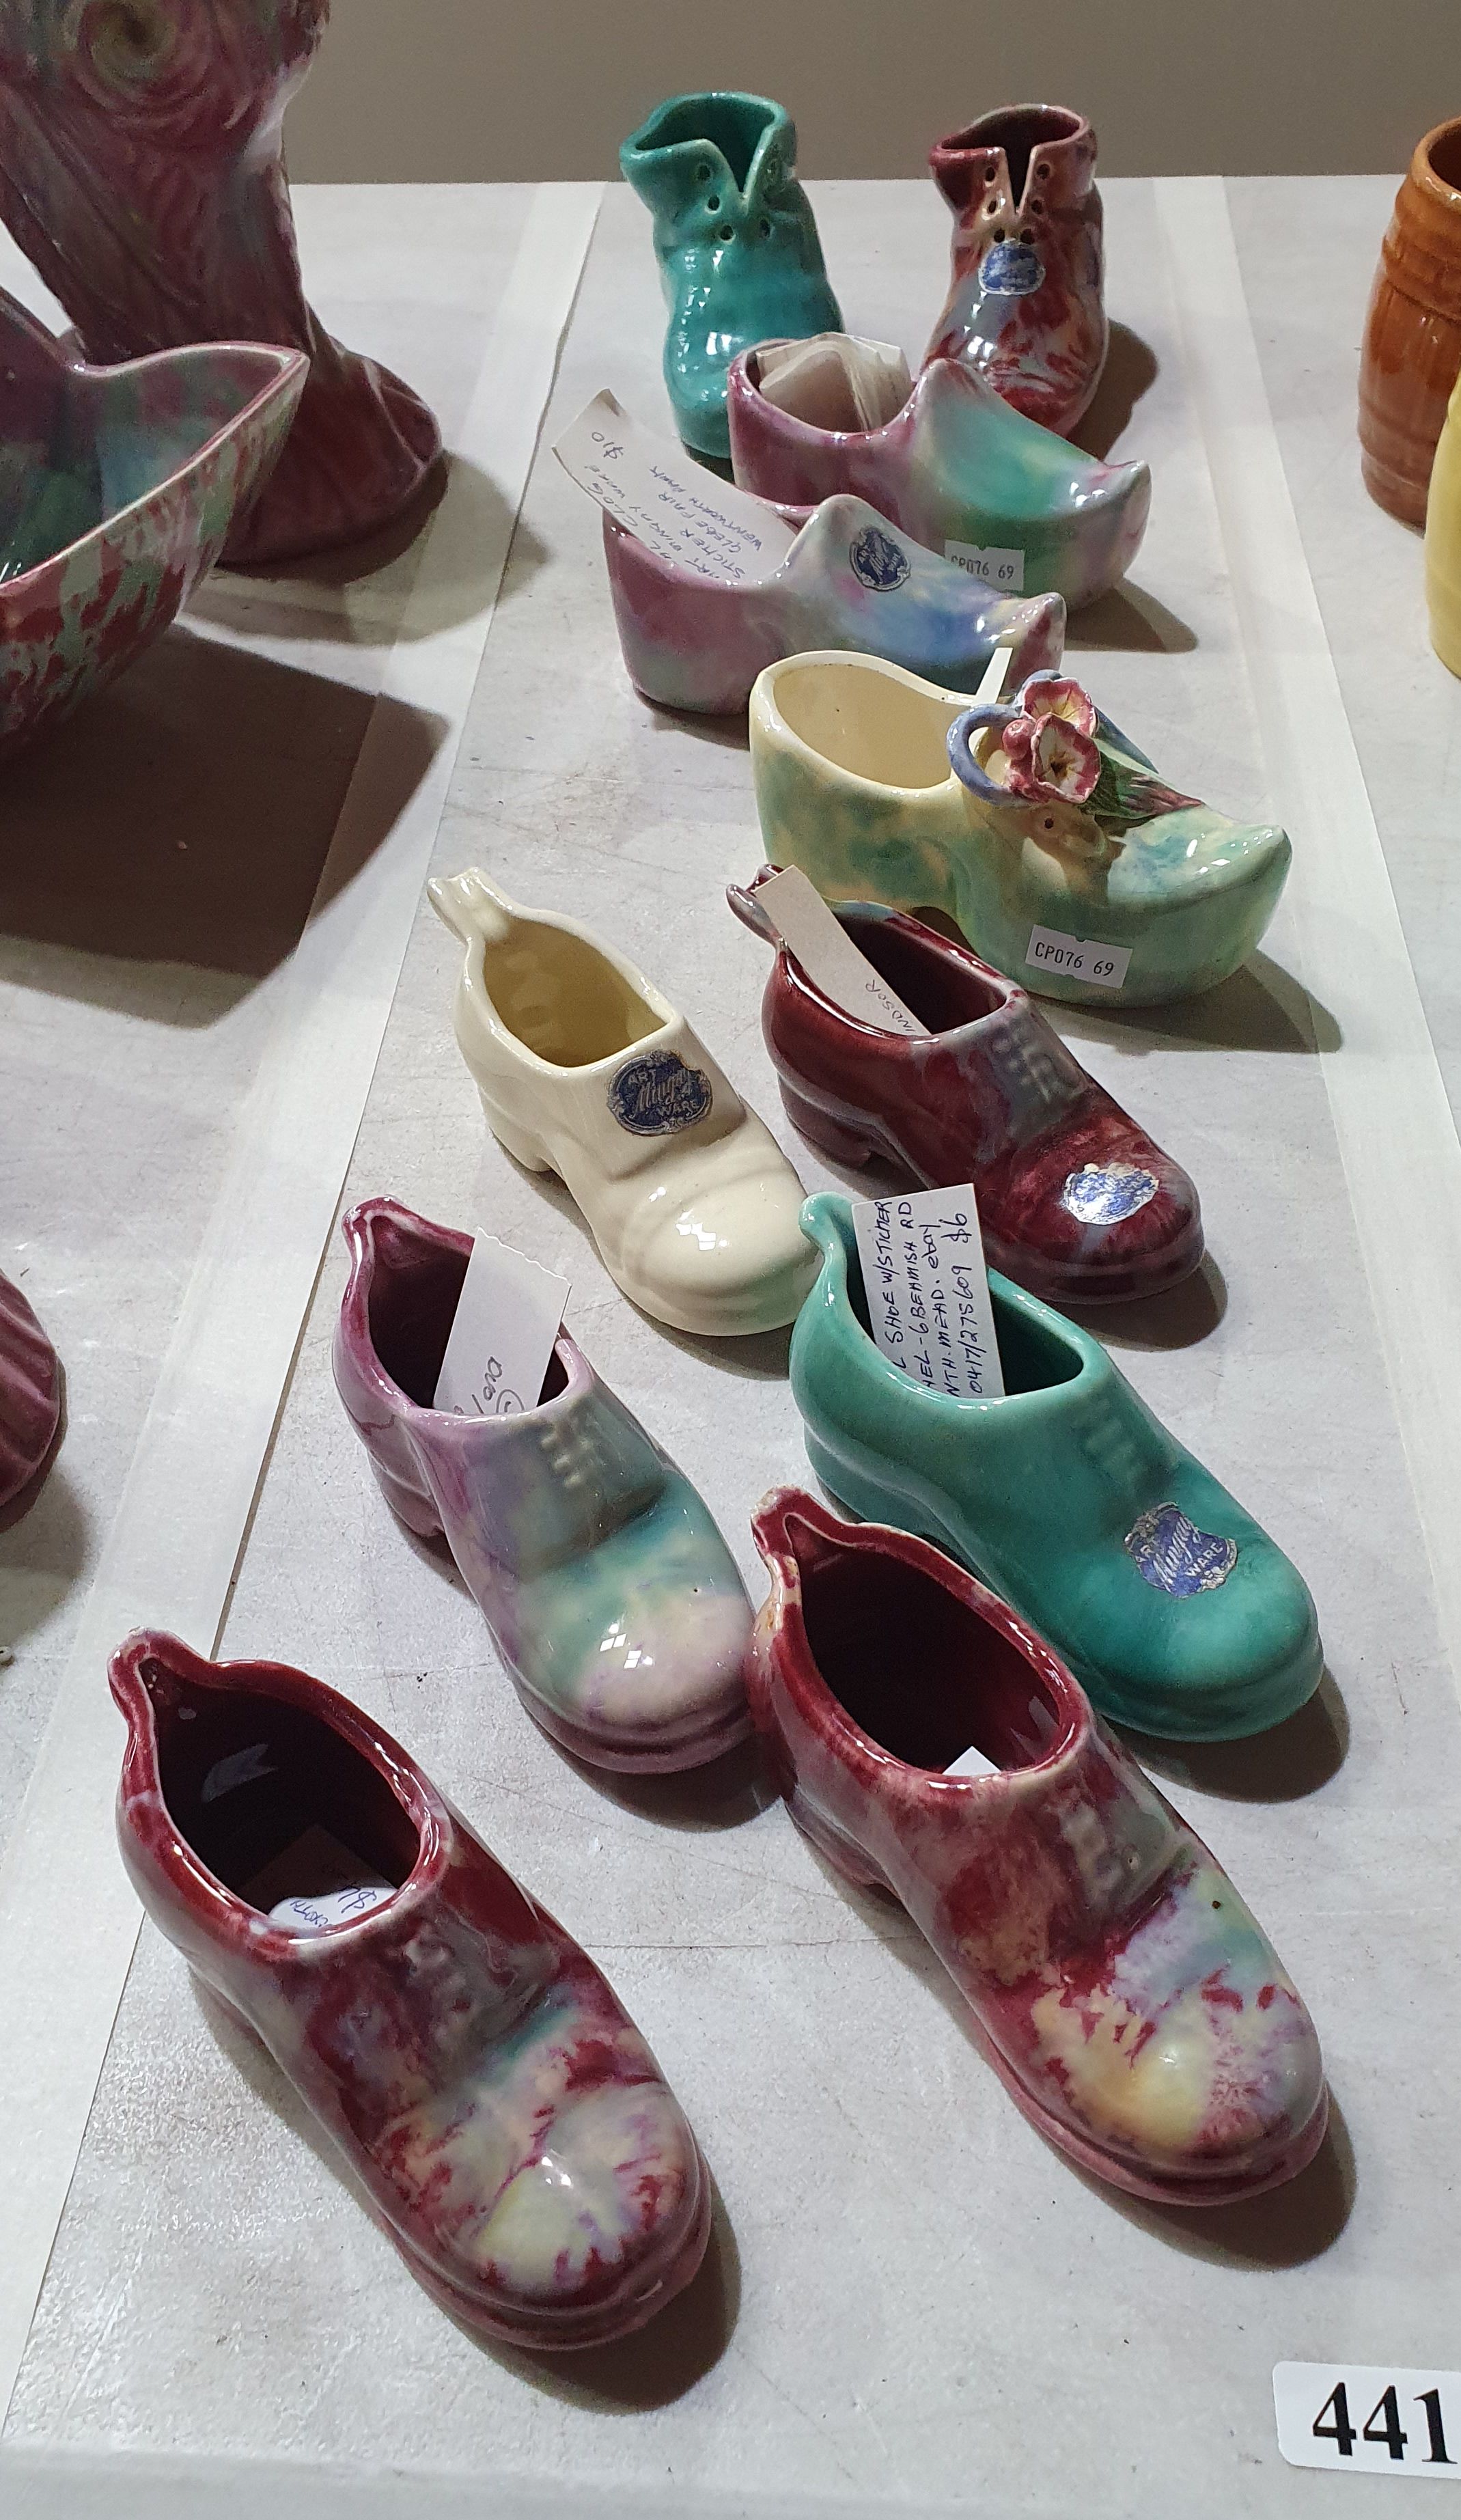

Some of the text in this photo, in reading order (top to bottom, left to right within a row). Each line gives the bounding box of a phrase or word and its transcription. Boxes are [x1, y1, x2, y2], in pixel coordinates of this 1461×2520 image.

[592, 432, 623, 459] $10
[587, 482, 638, 526] CLOG
[998, 564, 1014, 579] 69
[1093, 960, 1115, 977] 69
[898, 1202, 914, 1230] RD
[918, 1223, 941, 1269] ebay
[882, 1291, 904, 1344] SHOE
[938, 1213, 988, 1394] 0417/275609 $6
[1184, 1542, 1224, 1577] WARE
[1312, 2381, 1458, 2465] 441
